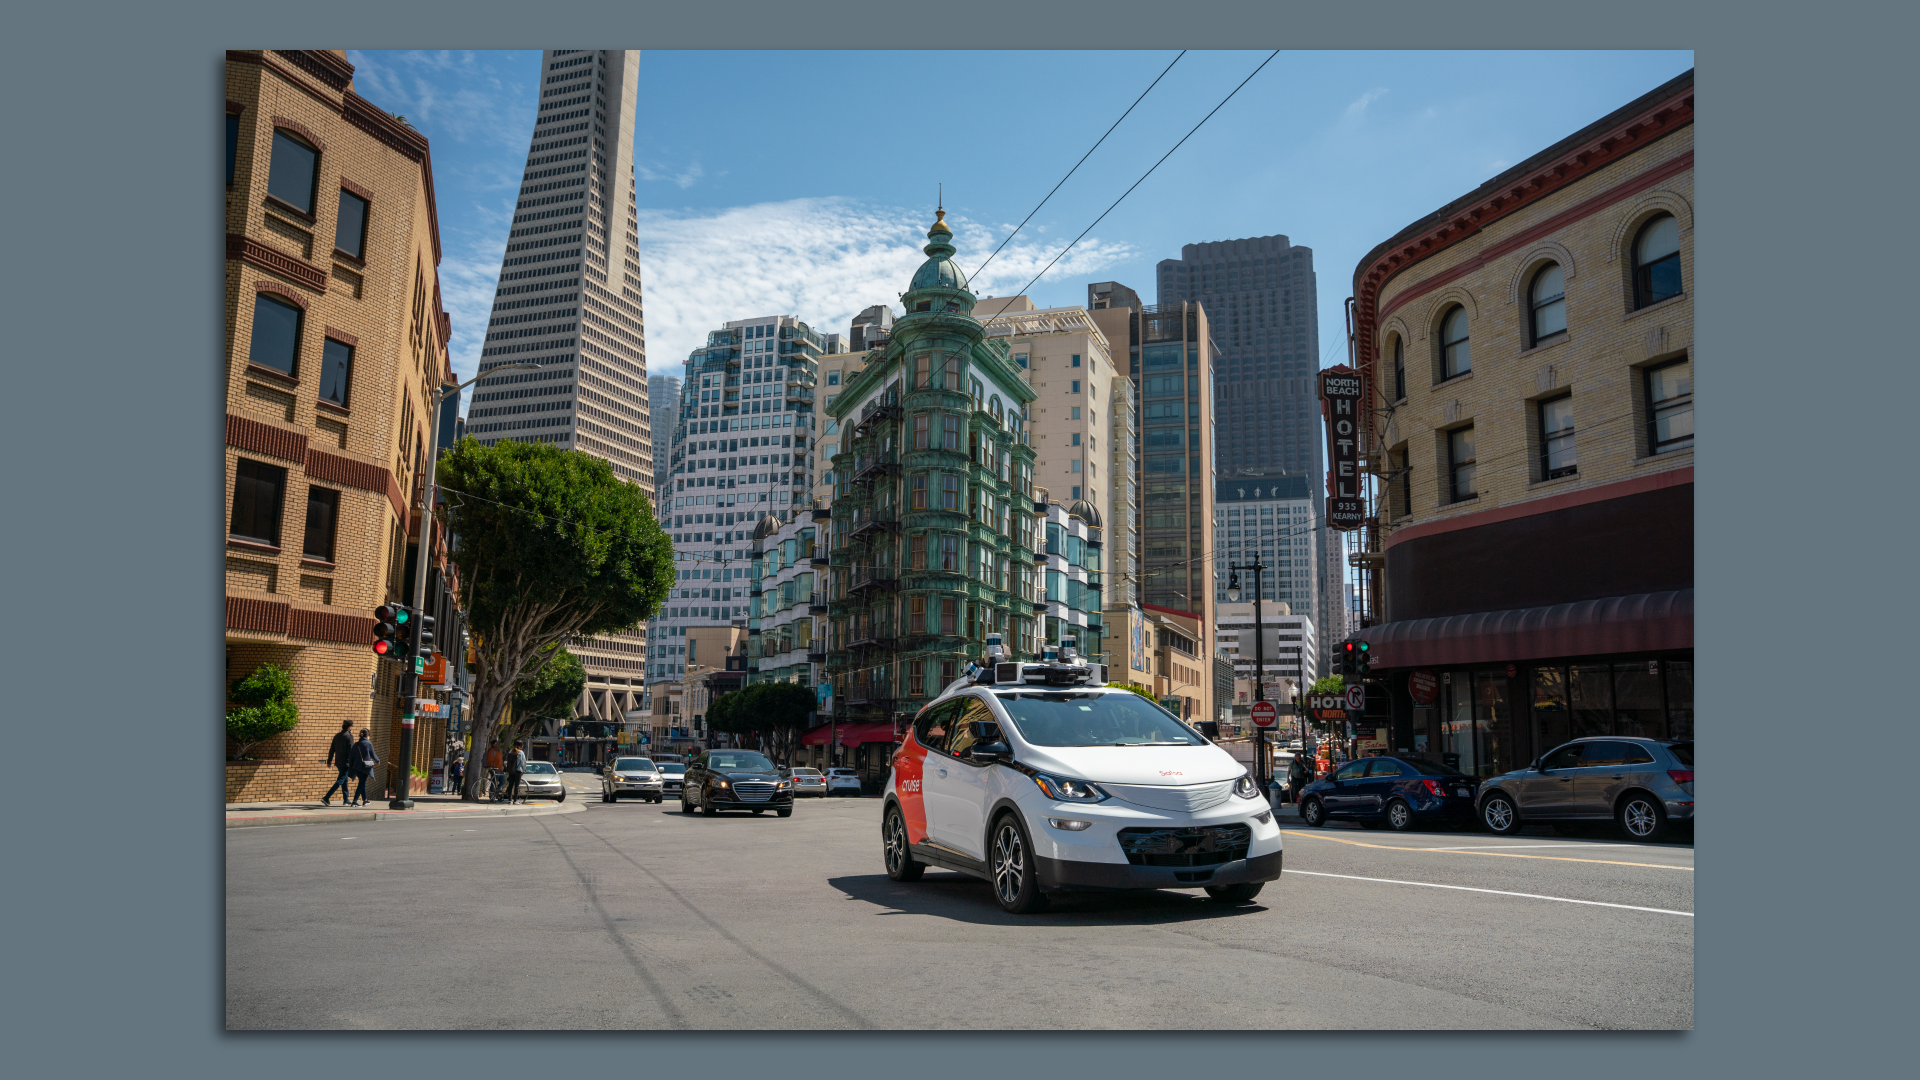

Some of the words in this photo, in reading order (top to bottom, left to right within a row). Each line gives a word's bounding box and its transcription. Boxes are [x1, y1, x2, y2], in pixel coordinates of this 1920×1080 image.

[1325, 378, 1359, 387] NORTH
[1326, 387, 1359, 396] BEACH
[1336, 399, 1355, 498] HOTEL
[1338, 502, 1356, 511] 935
[1332, 512, 1362, 521] KEARNY
[1367, 655, 1379, 665] fast
[1310, 696, 1345, 709] HOT
[450, 699, 460, 731] PARK
[1321, 709, 1346, 719] NORTH
[1364, 740, 1387, 749] Salon
[901, 774, 920, 793] cruise
